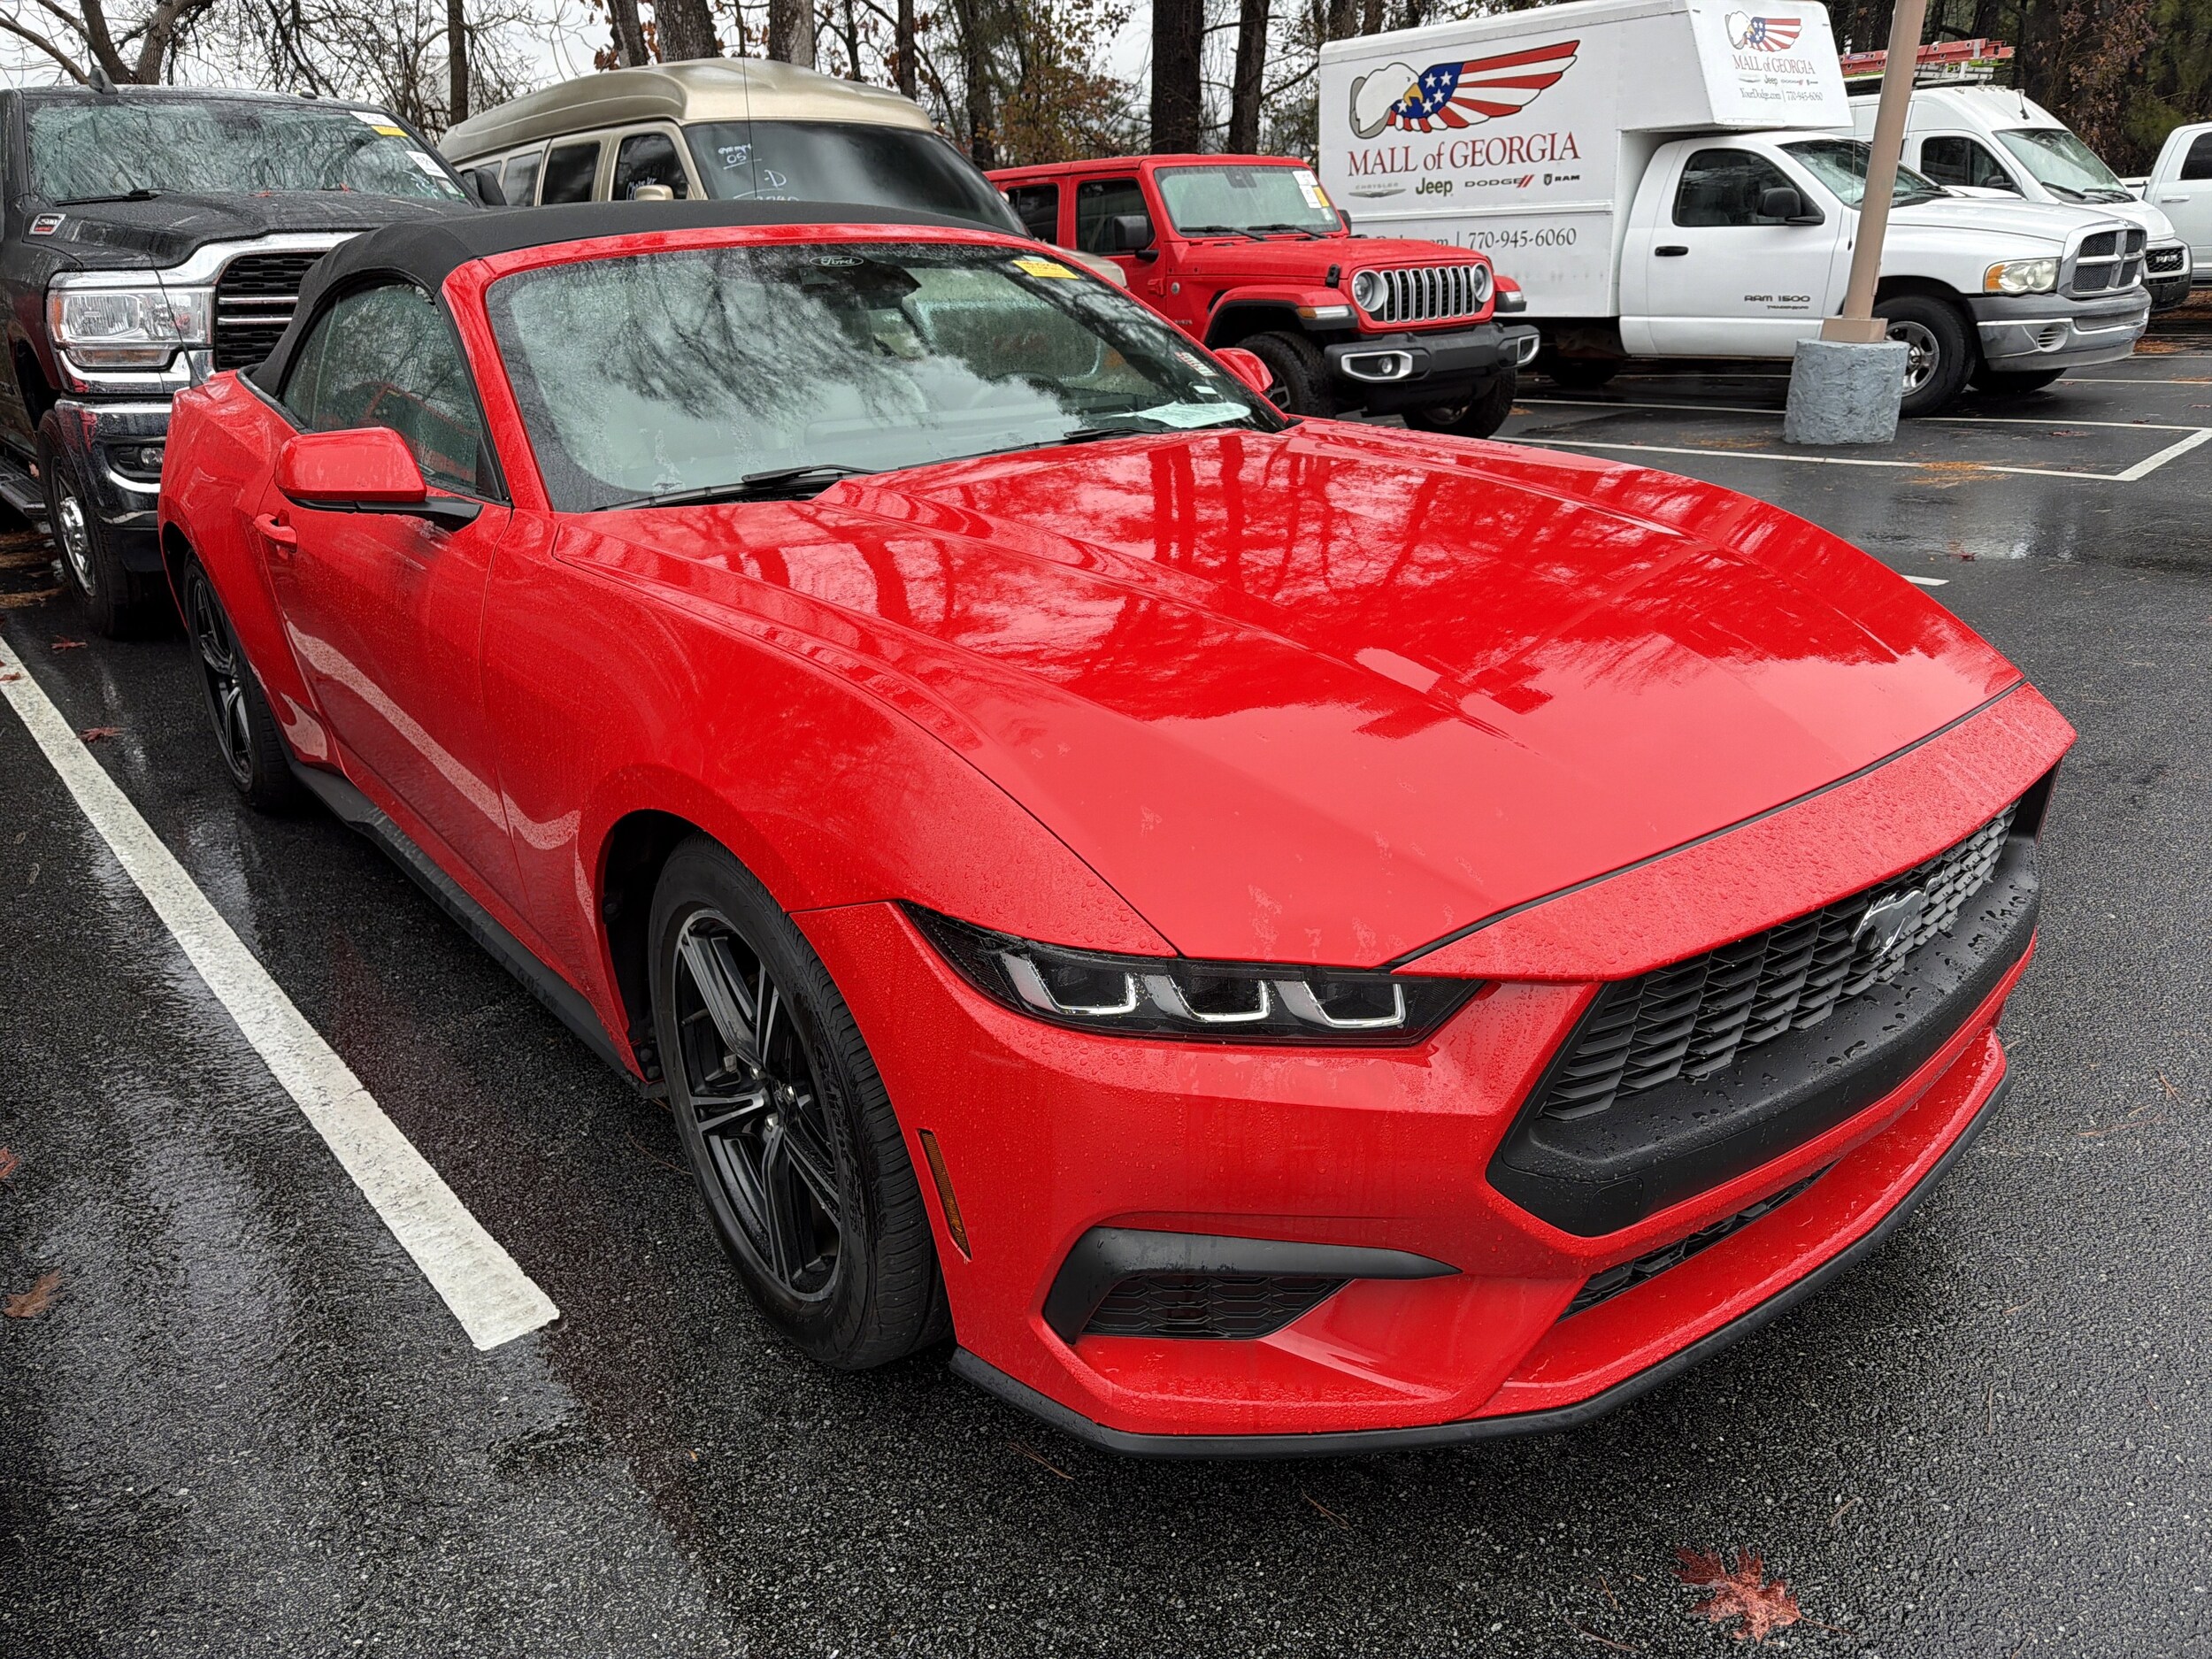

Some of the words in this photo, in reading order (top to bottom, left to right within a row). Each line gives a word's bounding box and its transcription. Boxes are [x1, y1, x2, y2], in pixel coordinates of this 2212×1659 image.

[1732, 54, 1763, 71] MALL
[1763, 57, 1771, 72] of
[1771, 58, 1816, 74] GEORGIA
[1764, 74, 1778, 86] Jeep
[1786, 90, 1824, 101] 770-945-6060
[1348, 145, 1417, 177] MALL
[1423, 142, 1445, 172] of
[1449, 131, 1581, 169] GEORGIA
[1416, 177, 1453, 196] Jeep
[1464, 178, 1524, 188] DODGE
[1468, 227, 1577, 250] 770-945-6060
[820, 256, 856, 265] Ford
